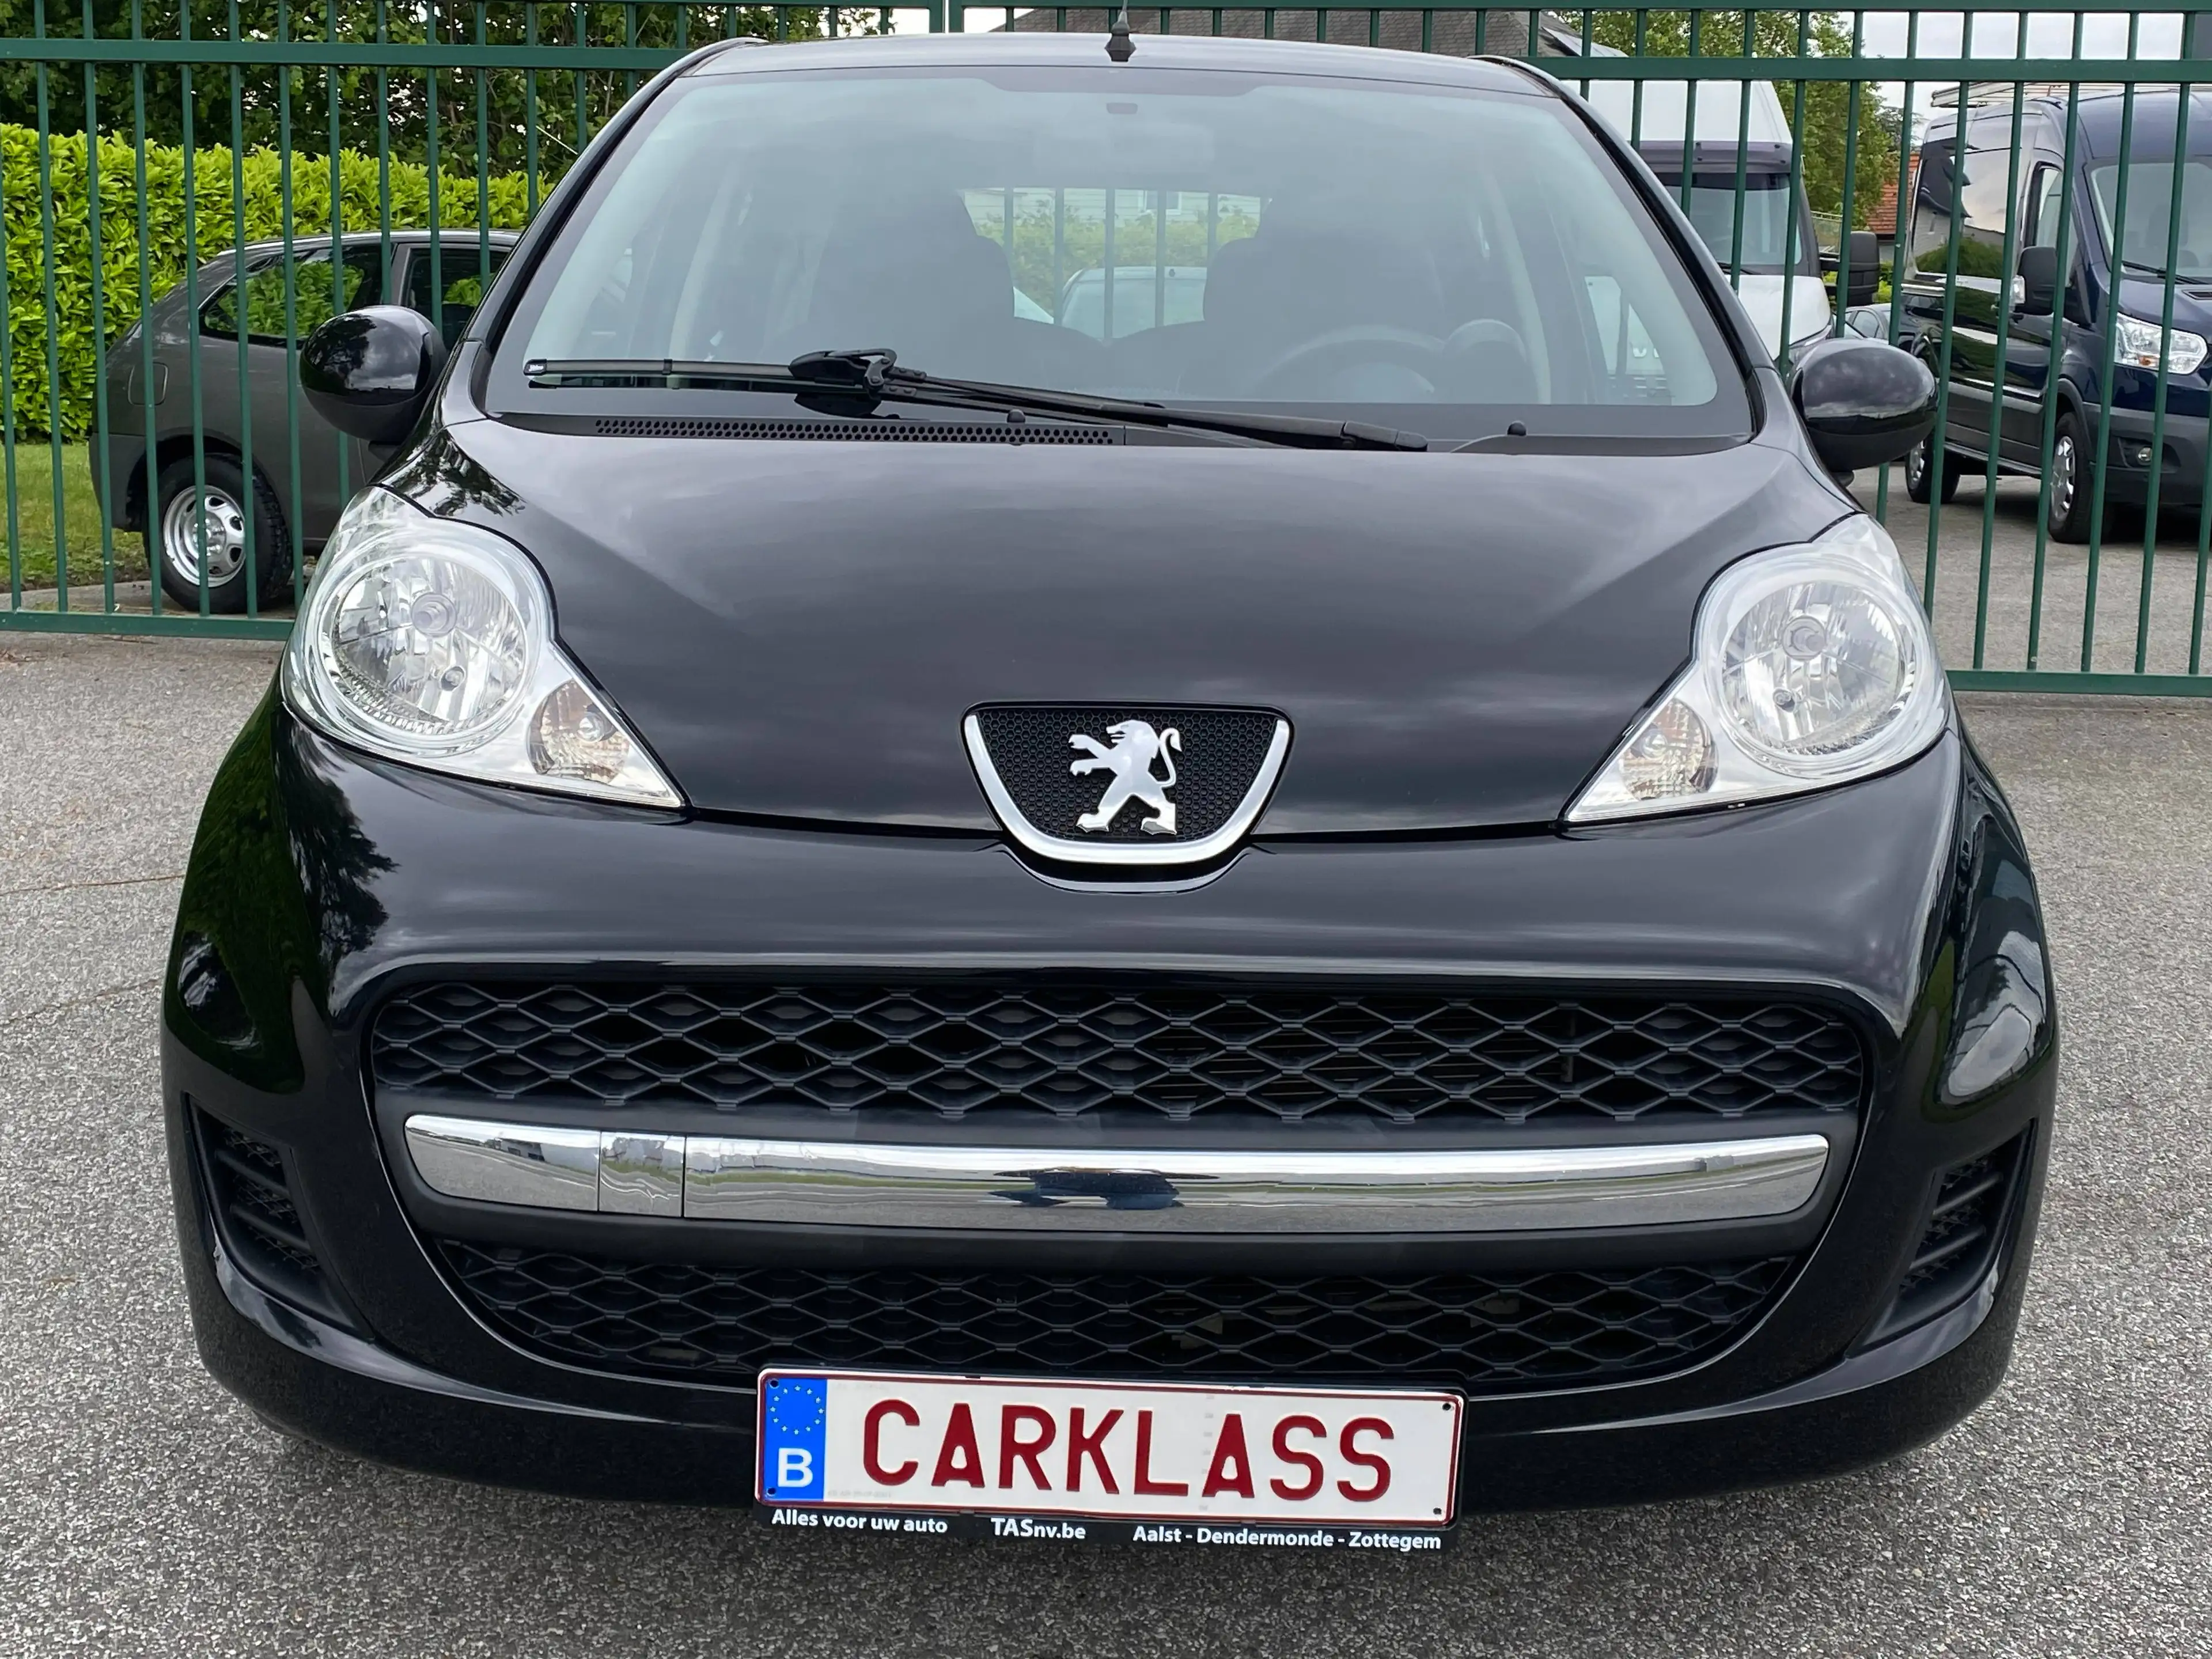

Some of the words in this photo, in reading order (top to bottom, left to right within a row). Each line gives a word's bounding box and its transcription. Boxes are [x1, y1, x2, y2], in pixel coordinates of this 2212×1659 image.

[777, 1447, 813, 1487] B
[863, 1399, 1395, 1502] CARKLASS
[771, 1509, 819, 1527] Alles
[823, 1514, 866, 1529] voor
[871, 1517, 899, 1531] uw
[903, 1518, 948, 1533] auto
[990, 1517, 1086, 1539] TASnv.be
[1132, 1525, 1182, 1543] Aalst
[1196, 1528, 1334, 1547] Dendermonde
[1349, 1531, 1441, 1552] Zottegem
